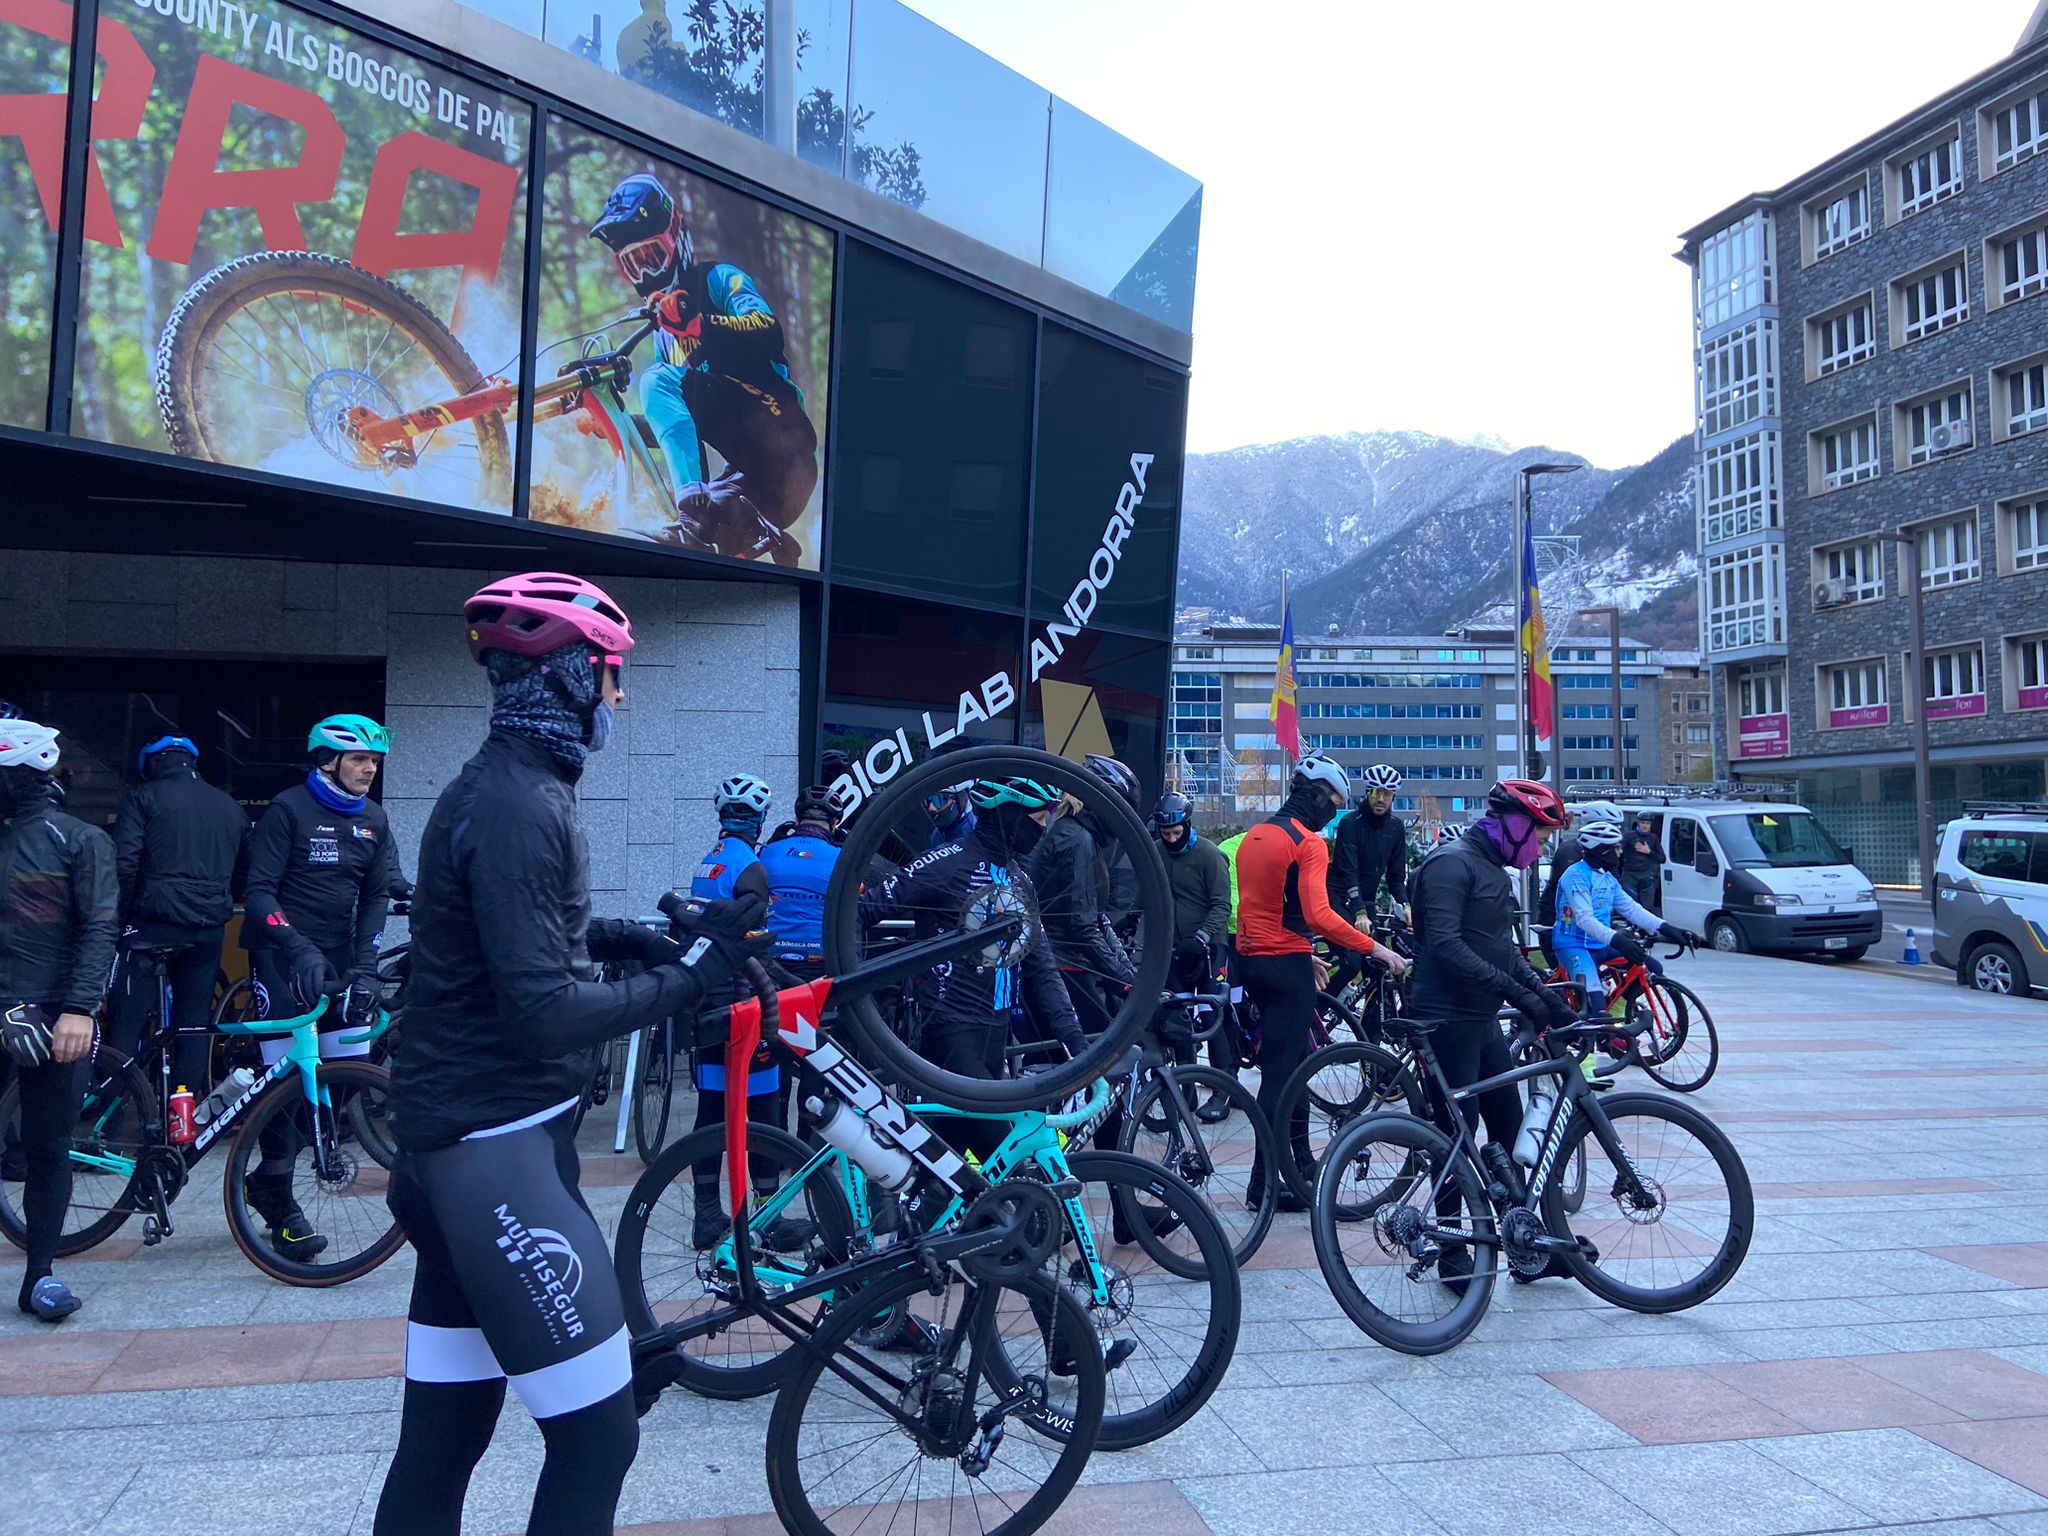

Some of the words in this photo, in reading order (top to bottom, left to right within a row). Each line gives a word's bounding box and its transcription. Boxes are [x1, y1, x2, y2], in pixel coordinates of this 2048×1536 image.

[134, 0, 259, 48] UNTY
[264, 20, 319, 71] ALS
[327, 43, 431, 115] BOSCOS
[438, 87, 470, 131] DE
[476, 104, 521, 151] PAL
[590, 627, 617, 648] SMITH
[828, 727, 914, 828] BICI
[921, 671, 1016, 750] LAB
[1030, 452, 1155, 683] ANDORRA
[778, 1012, 964, 1196] TREK
[1531, 1096, 1574, 1198] SPECIALIZED
[493, 1203, 585, 1339] MULTISEGUR
[1071, 1199, 1098, 1265] ianchi
